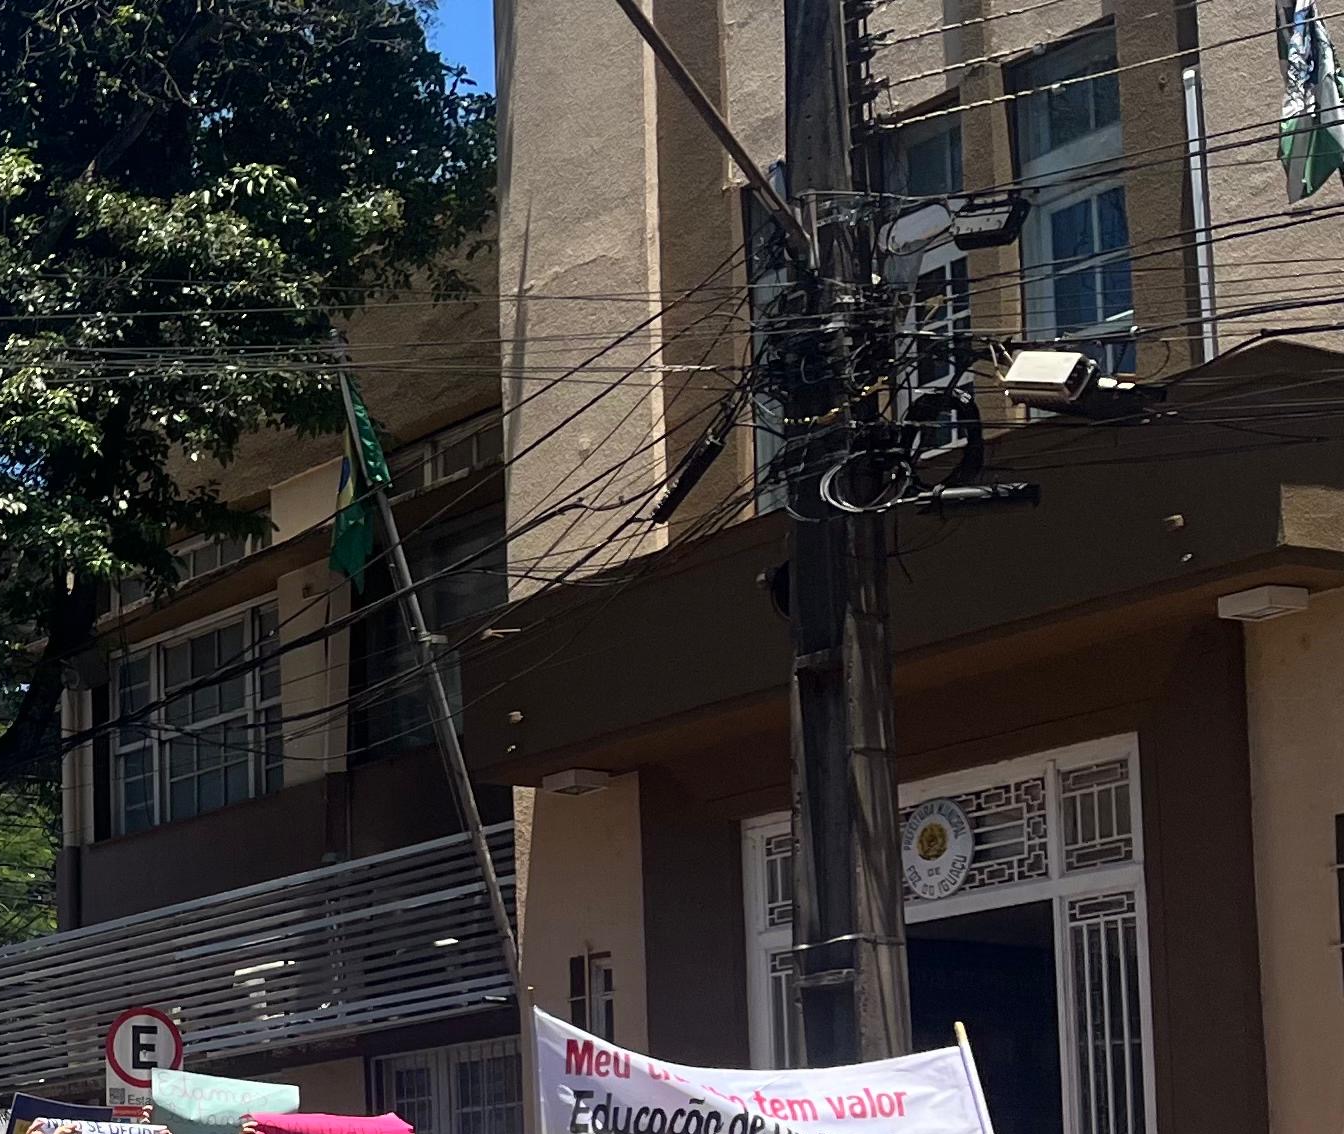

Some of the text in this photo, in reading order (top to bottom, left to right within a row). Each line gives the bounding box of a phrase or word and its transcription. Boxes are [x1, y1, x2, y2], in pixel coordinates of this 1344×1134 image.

[132, 1025, 158, 1069] E
[565, 1038, 907, 1121] Meu tem valor
